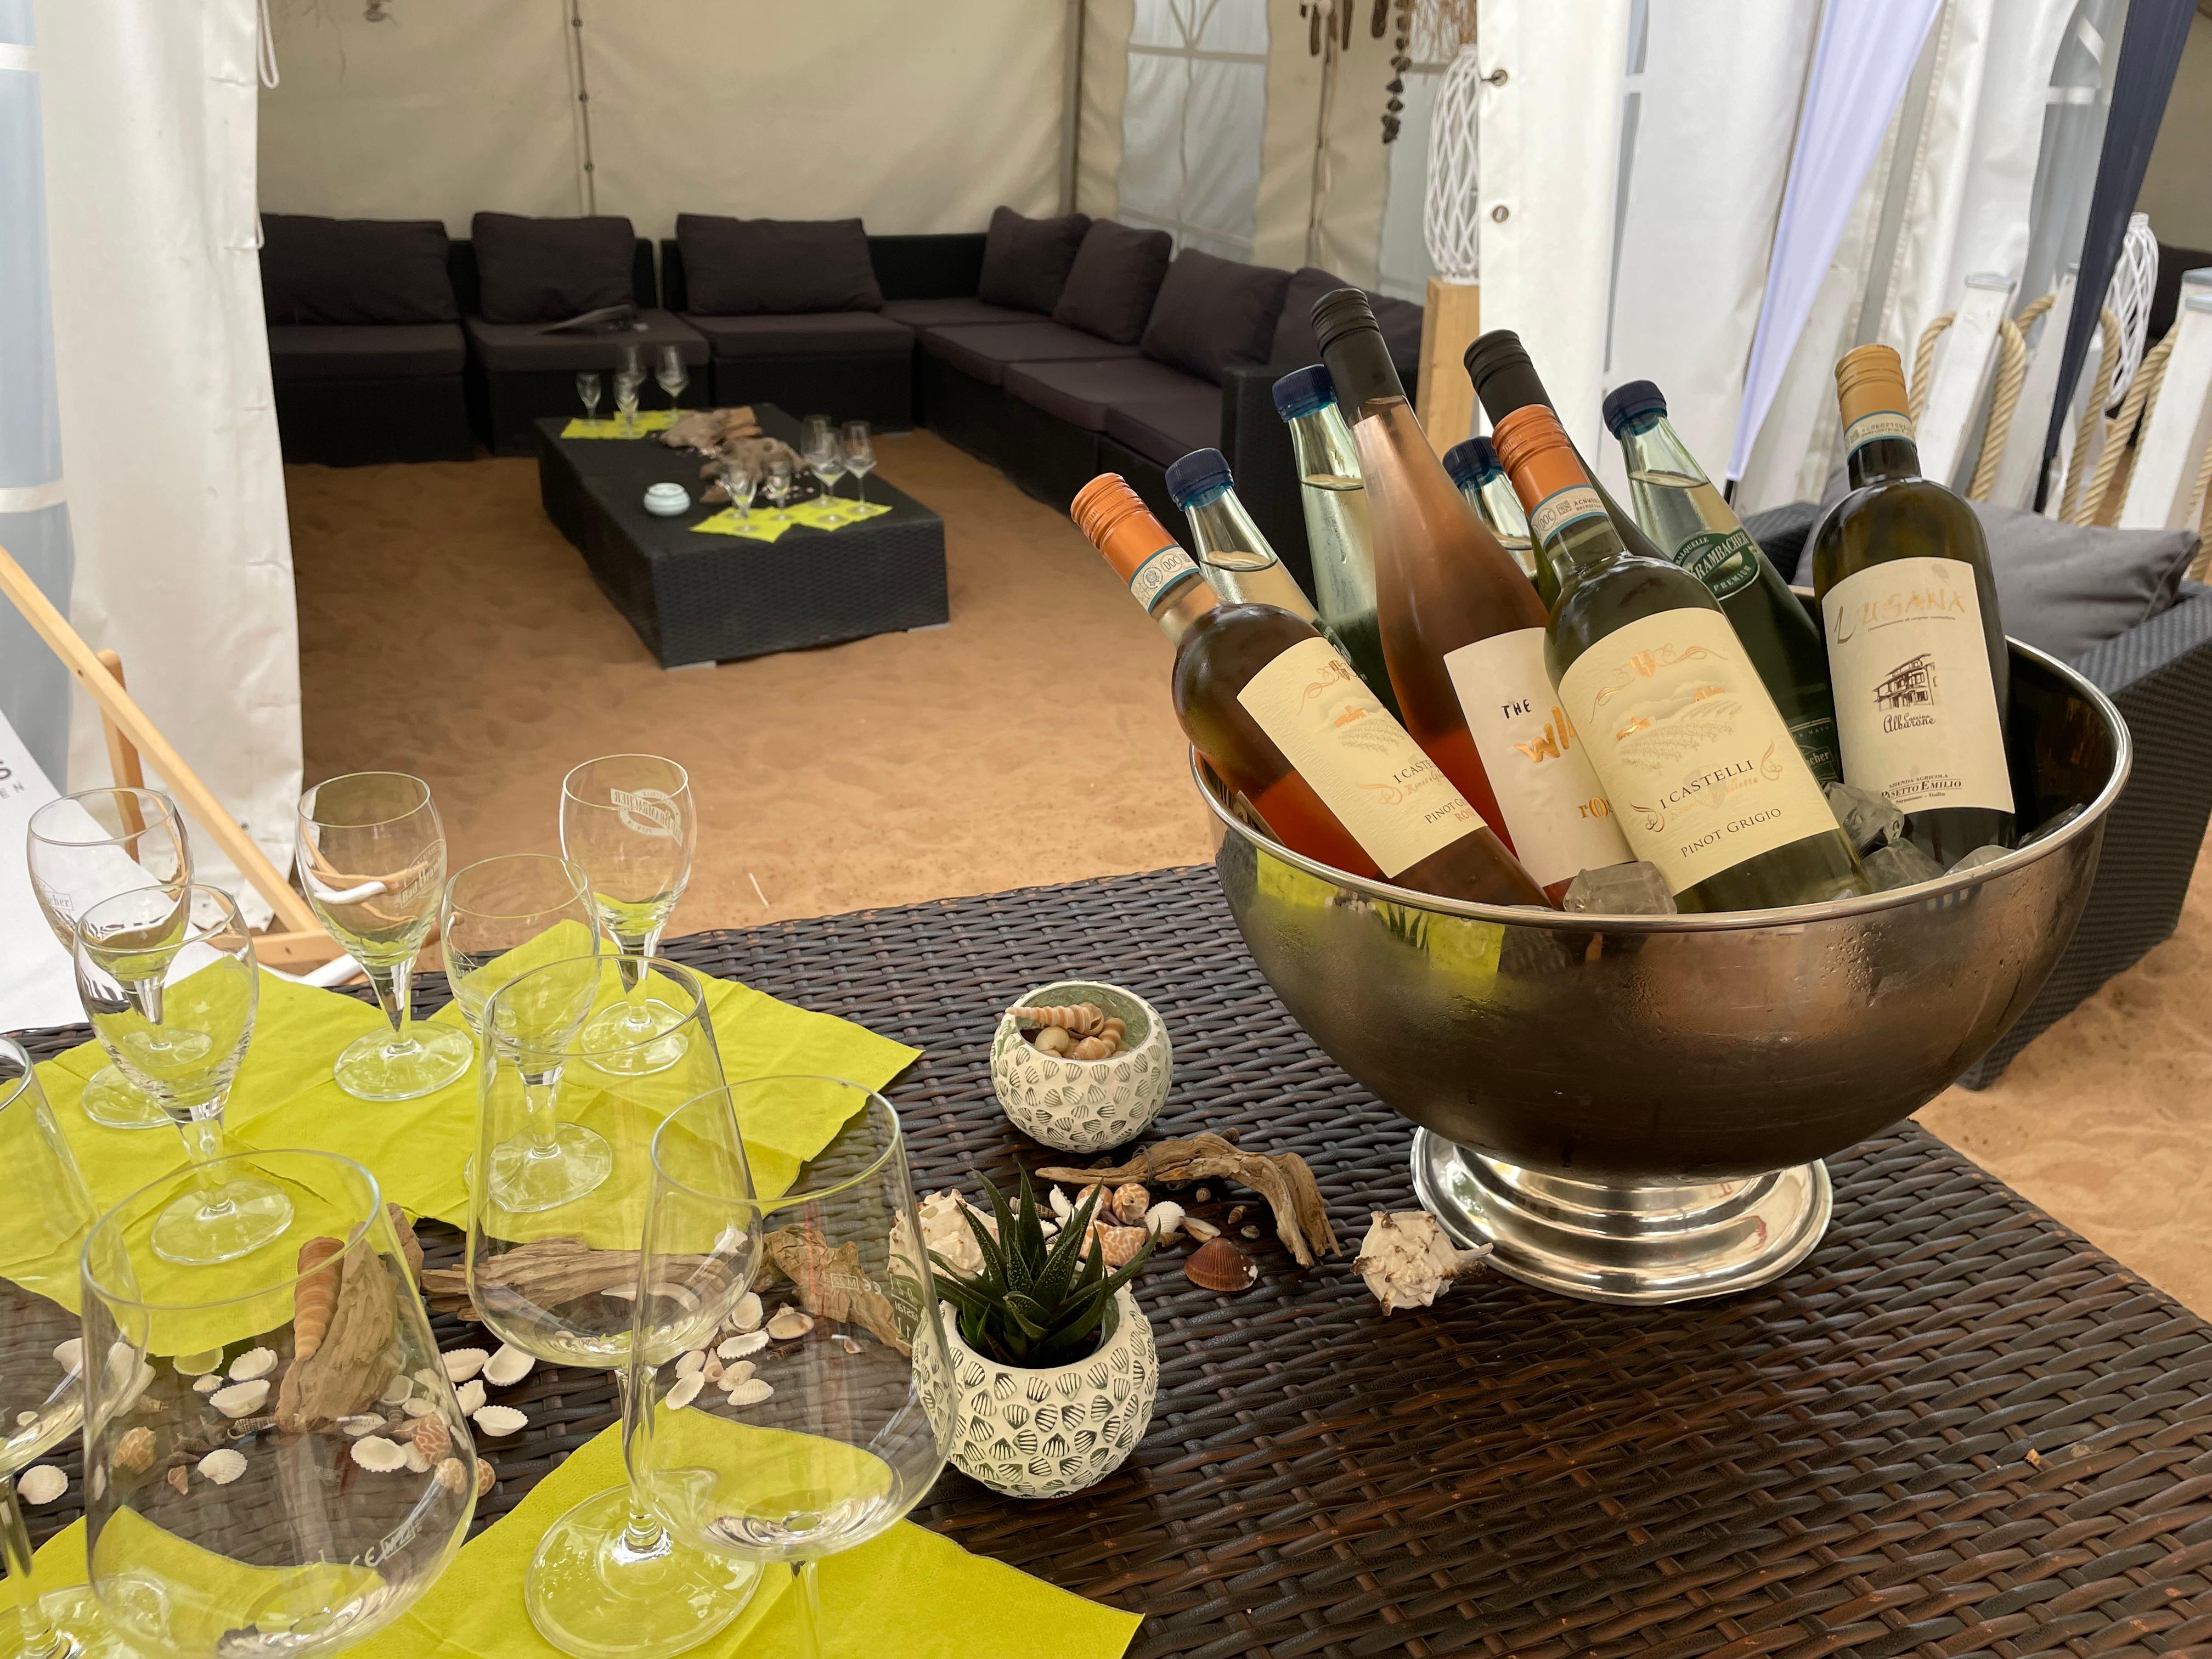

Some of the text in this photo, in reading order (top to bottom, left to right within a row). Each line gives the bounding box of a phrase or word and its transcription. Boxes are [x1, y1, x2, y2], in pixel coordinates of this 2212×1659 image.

[1539, 510, 1554, 529] DOC
[1163, 556, 1181, 571] DOC
[1501, 698, 1532, 719] THE
[1883, 714, 1936, 733] Albarone
[1392, 774, 1402, 784] I
[1401, 759, 1436, 778] CASTE
[1888, 773, 1949, 788] AZIENDA AGRICOLA
[1660, 799, 1667, 809] I
[1669, 760, 1754, 802] CASTELLI
[1881, 780, 1961, 799] PASETTO EMILIO
[1424, 802, 1455, 823] PINOT
[1680, 830, 1722, 857] PINOT
[1726, 808, 1781, 836] GRIGIO
[402, 880, 418, 904] Bad
